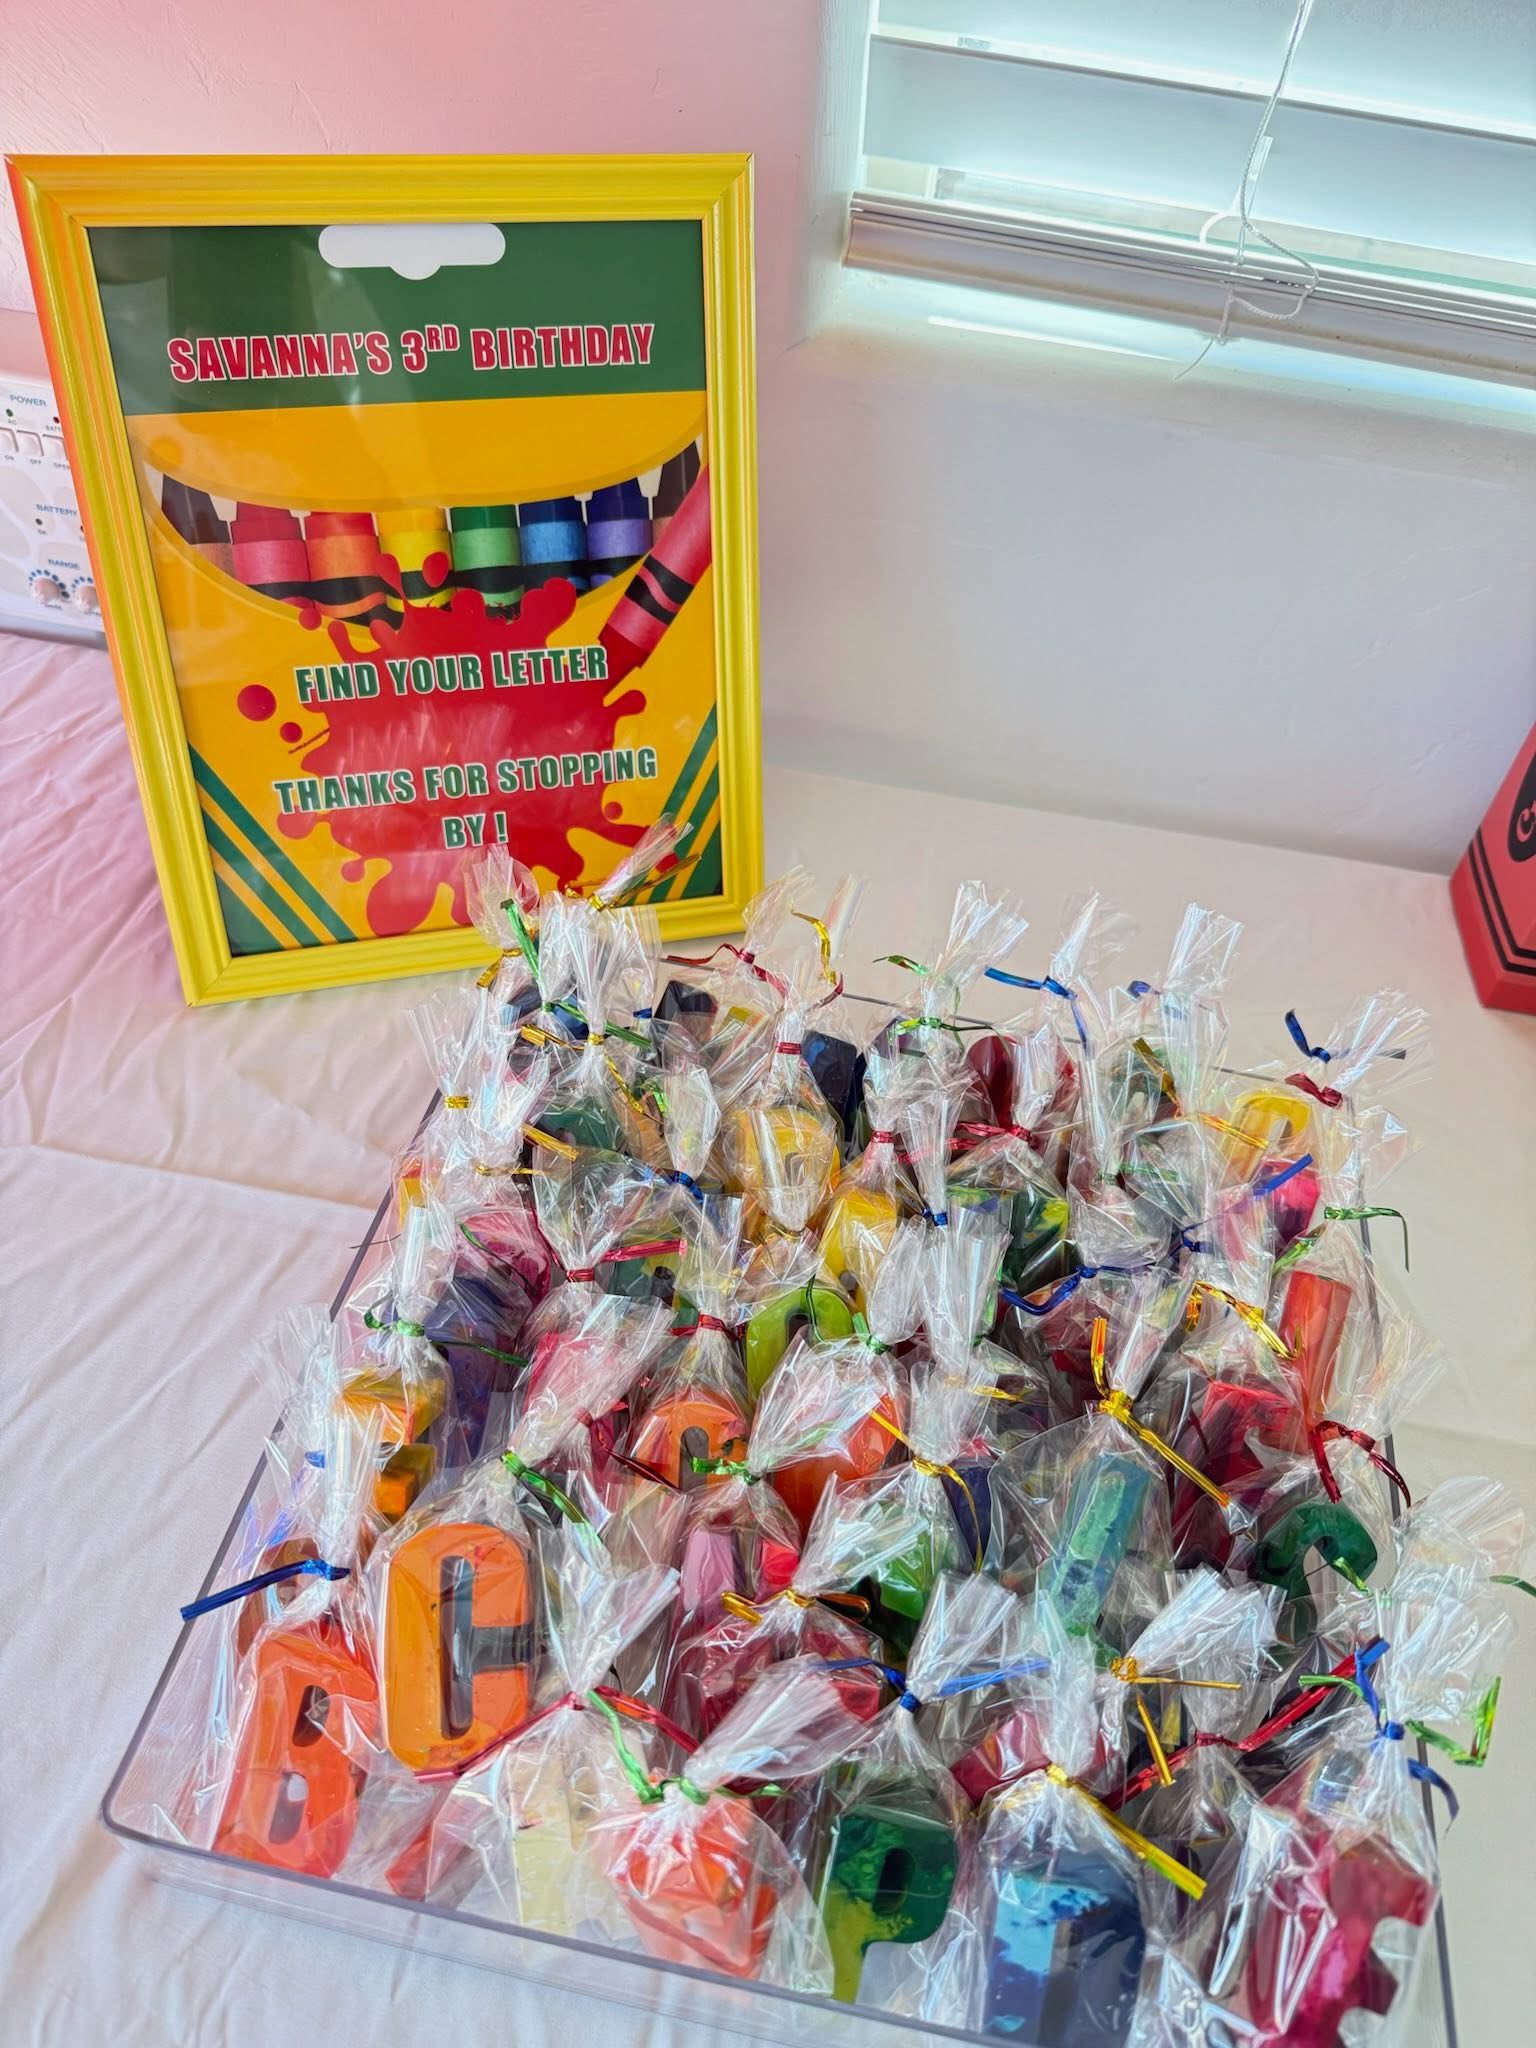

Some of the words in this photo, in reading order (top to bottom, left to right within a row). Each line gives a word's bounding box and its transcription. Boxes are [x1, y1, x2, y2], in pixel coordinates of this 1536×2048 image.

[167, 331, 392, 383] SAVANNA'S
[401, 324, 460, 374] 3RD
[470, 323, 655, 371] BIRTHDAY
[10, 394, 47, 407] POWER
[36, 503, 77, 517] BATTERY
[294, 661, 379, 704] FIND
[387, 653, 482, 695] YOUR
[491, 645, 608, 687] LETTER
[272, 768, 416, 815] THANKS
[423, 760, 489, 801] FOR
[497, 746, 657, 794] STOPPING
[441, 815, 487, 849] BY
[496, 811, 510, 845] !
